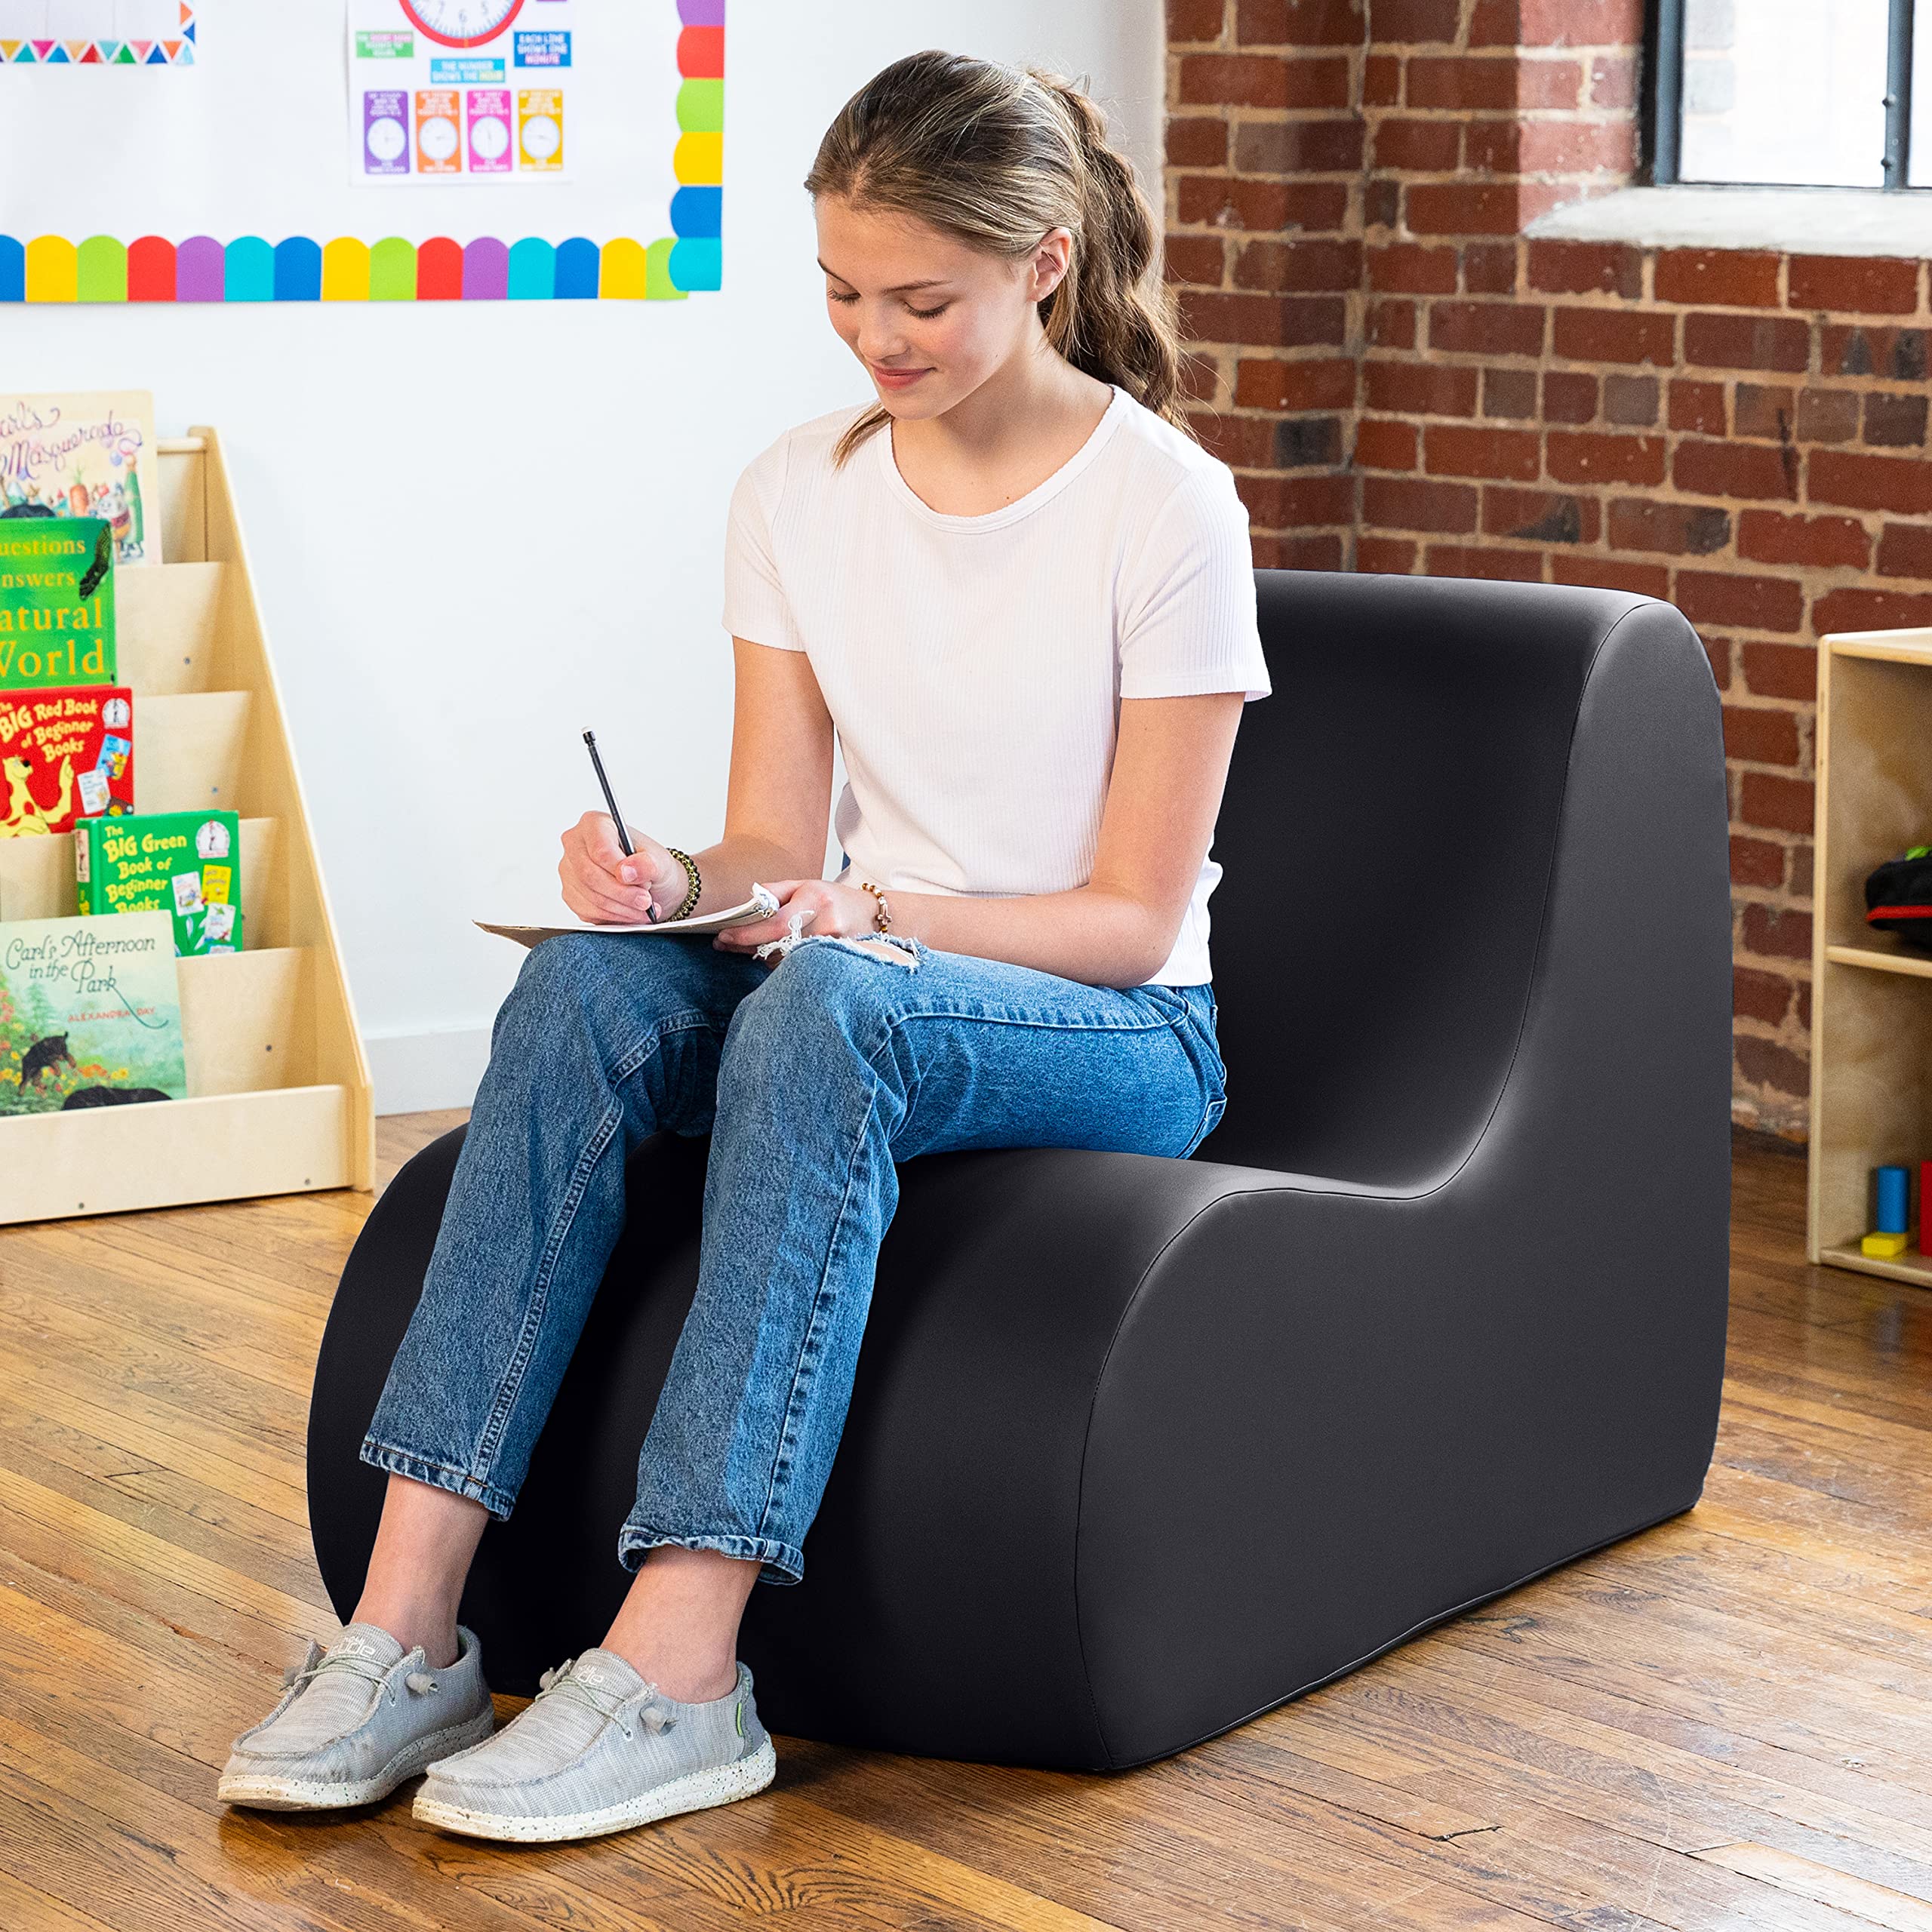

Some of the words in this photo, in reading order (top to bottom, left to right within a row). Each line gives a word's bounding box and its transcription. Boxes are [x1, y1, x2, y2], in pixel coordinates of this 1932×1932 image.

[0, 401, 60, 438] arl's
[3, 410, 142, 480] Masquerade
[0, 535, 86, 556] uestions
[2, 571, 75, 588] nswers
[0, 598, 103, 632] atural
[0, 703, 14, 715] he
[0, 705, 34, 743] BIG
[33, 699, 63, 721] Red
[64, 698, 98, 716] Book
[20, 732, 33, 749] of
[33, 721, 94, 746] Beginner
[41, 737, 85, 763] Books
[104, 826, 124, 838] The
[103, 835, 138, 863] BIG
[141, 833, 187, 853] Green
[117, 856, 152, 880] Book
[156, 857, 173, 870] of
[106, 878, 168, 903] Beginner
[115, 896, 161, 914] Books
[6, 935, 57, 970] Carl's
[61, 930, 155, 958] Afternoon
[29, 963, 44, 979] in
[46, 958, 69, 982] the
[71, 958, 117, 994] Park
